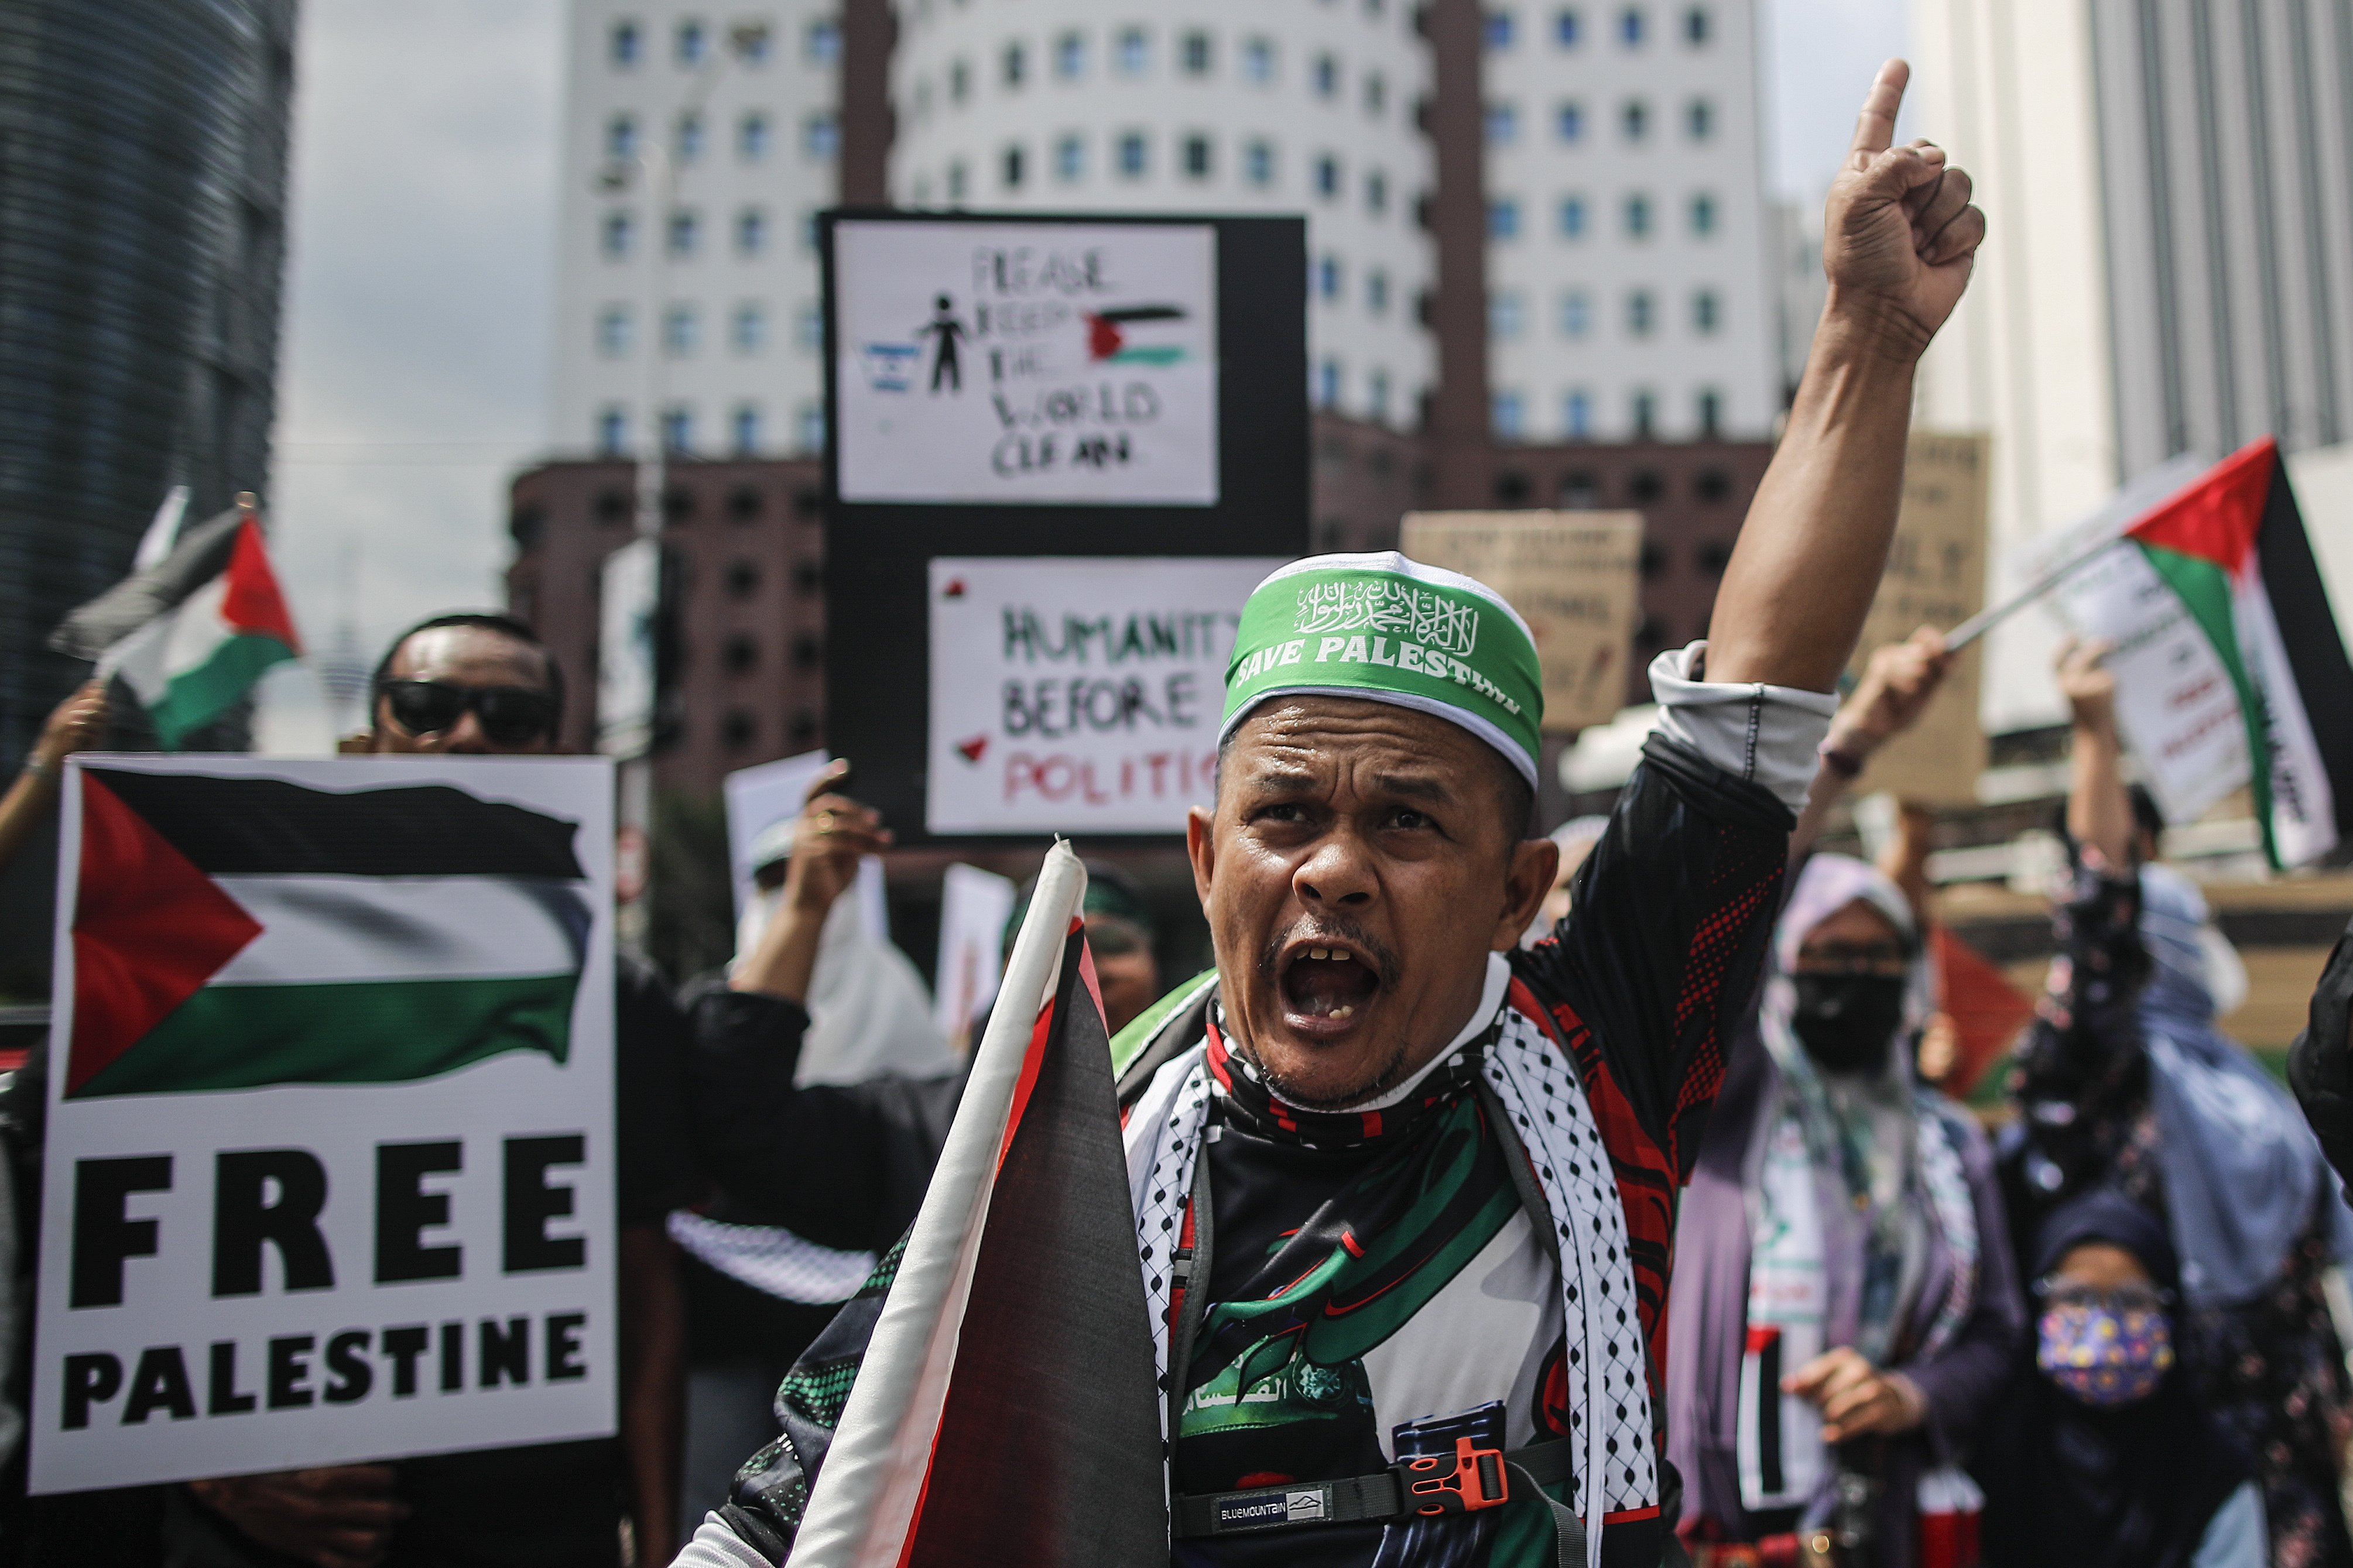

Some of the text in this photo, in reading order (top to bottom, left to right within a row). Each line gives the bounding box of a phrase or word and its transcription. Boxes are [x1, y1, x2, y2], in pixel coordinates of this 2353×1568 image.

[1003, 672, 1198, 739] BEFORE
[1235, 639, 1307, 689] SAVE
[69, 1133, 587, 1309] FREE
[61, 1311, 588, 1431] PALESTINE
